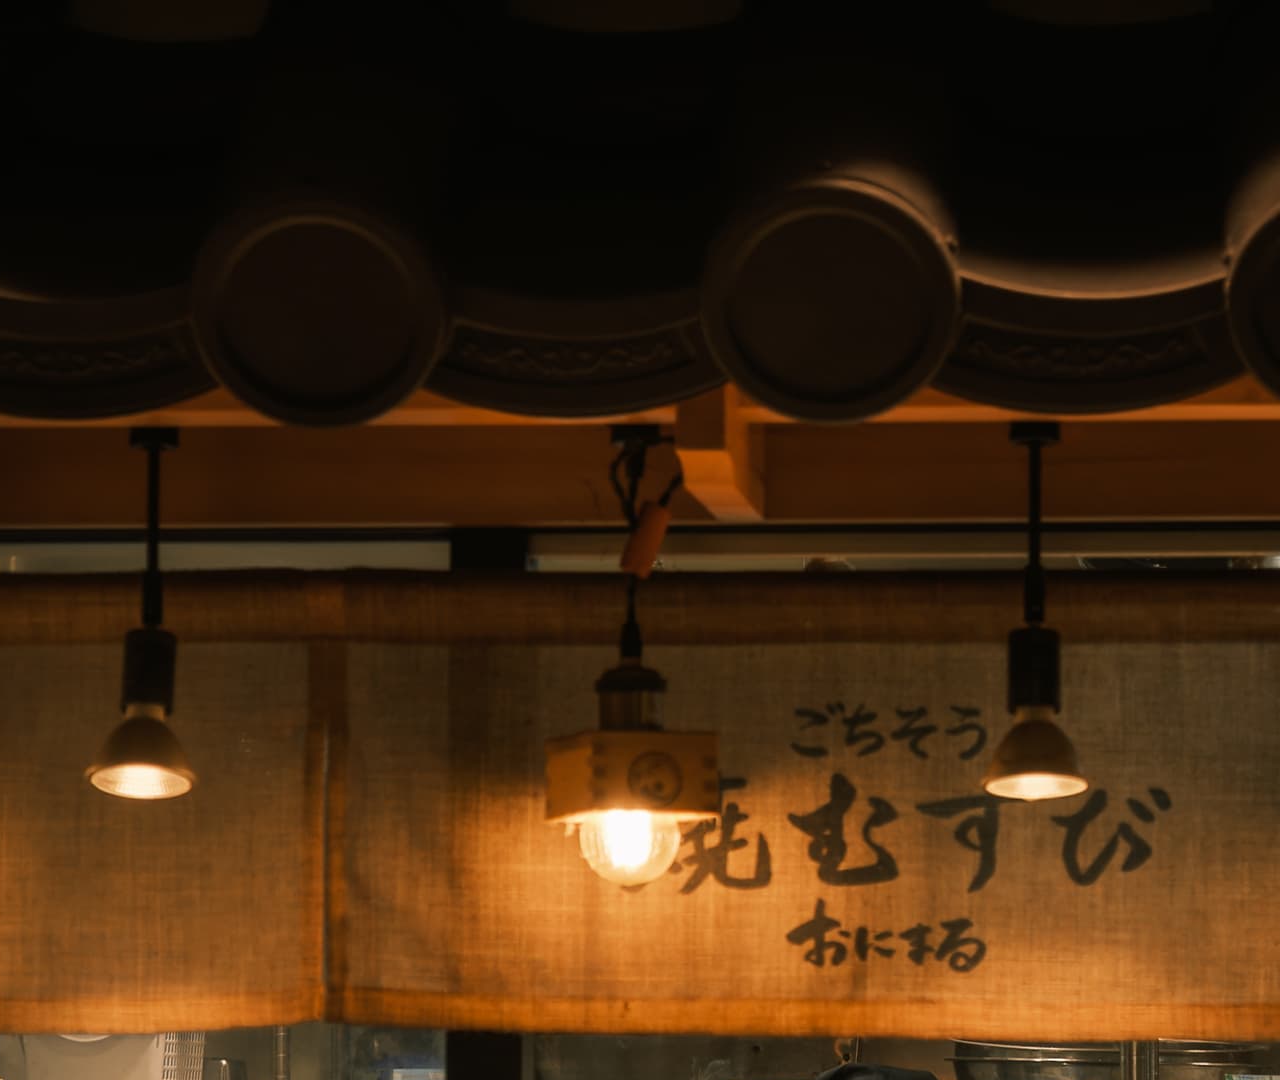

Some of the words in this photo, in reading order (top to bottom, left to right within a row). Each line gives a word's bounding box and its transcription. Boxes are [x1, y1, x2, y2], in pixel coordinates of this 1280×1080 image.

[791, 703, 987, 759] ごちそう
[786, 900, 987, 972] おにまる
